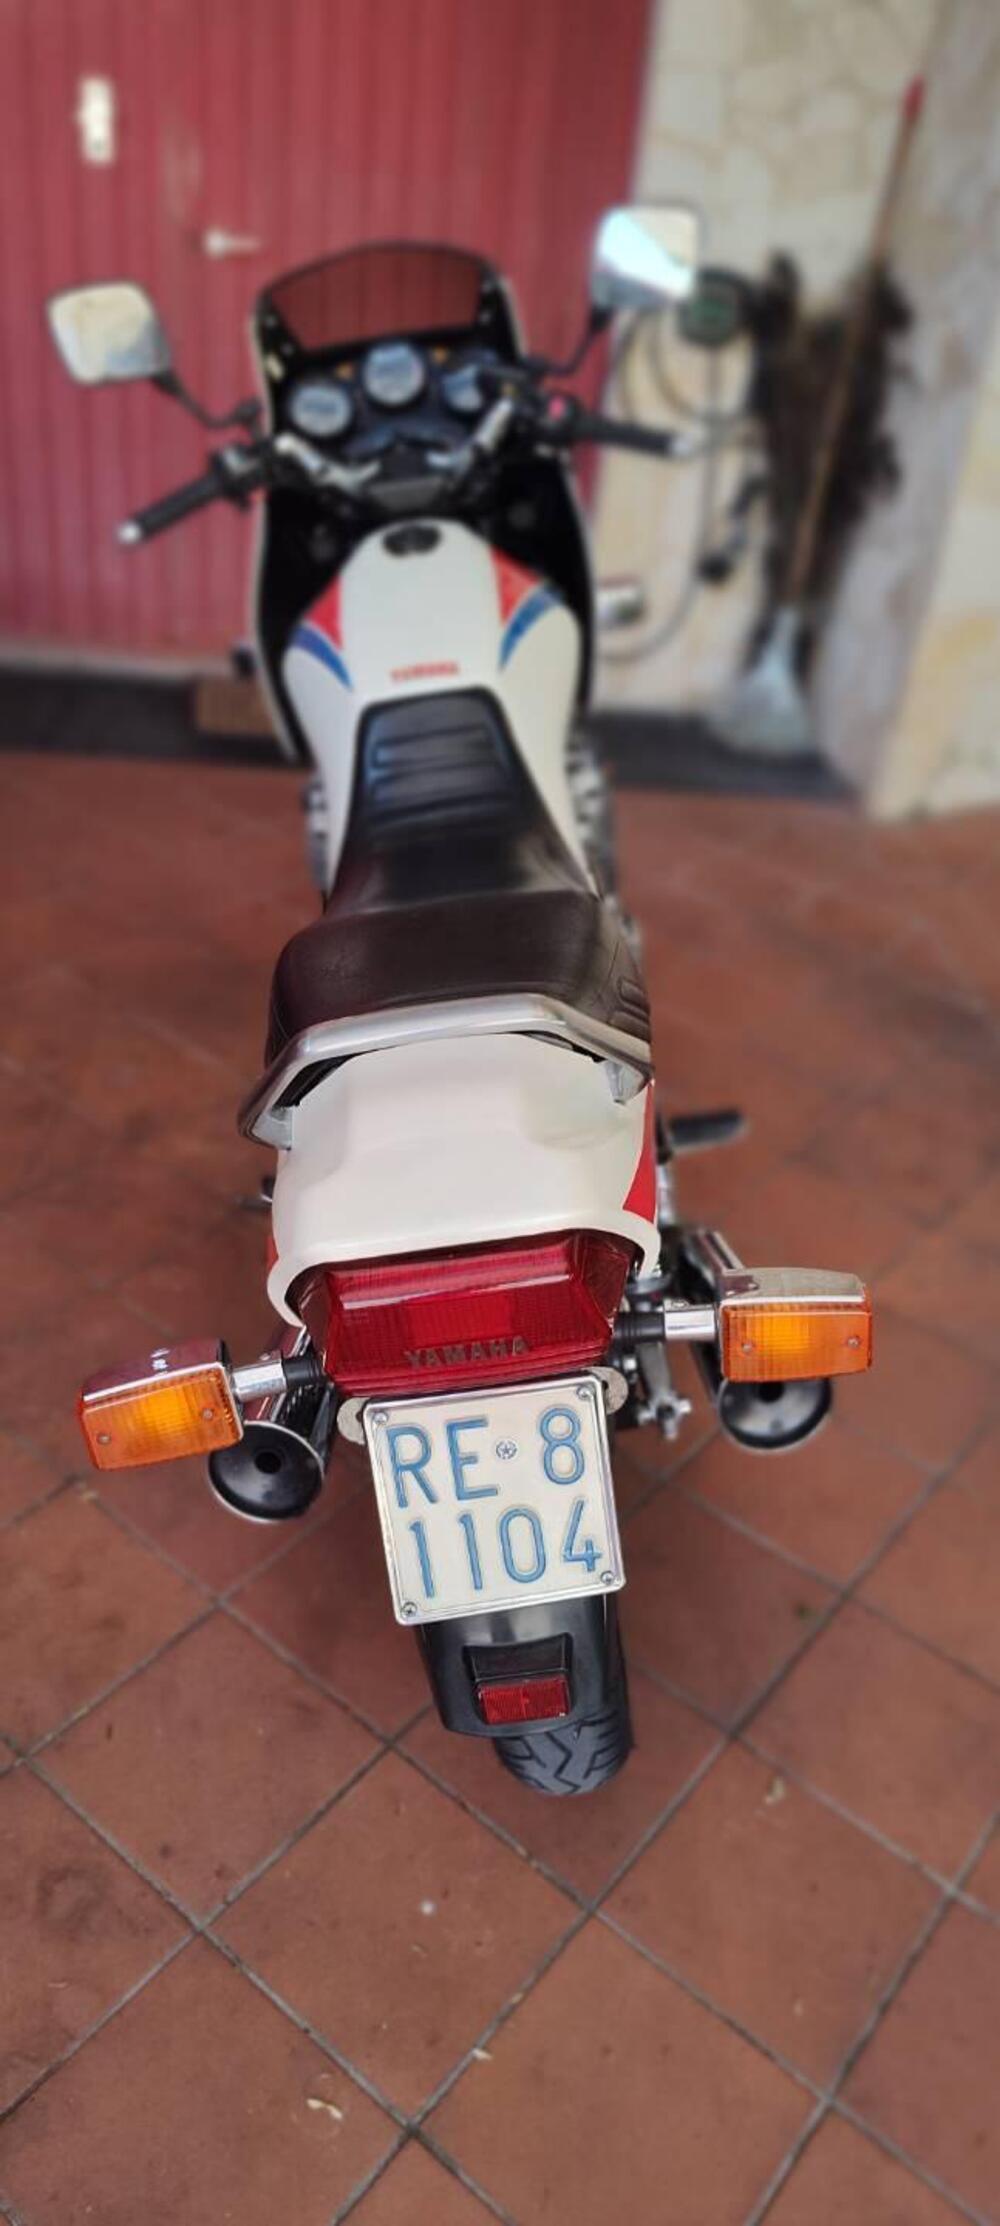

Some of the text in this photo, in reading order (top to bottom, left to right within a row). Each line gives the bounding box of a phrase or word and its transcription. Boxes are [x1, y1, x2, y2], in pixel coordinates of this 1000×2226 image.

[405, 1336, 529, 1368] YAMAHA
[385, 1406, 586, 1509] RE 8
[409, 1499, 603, 1599] 1104
